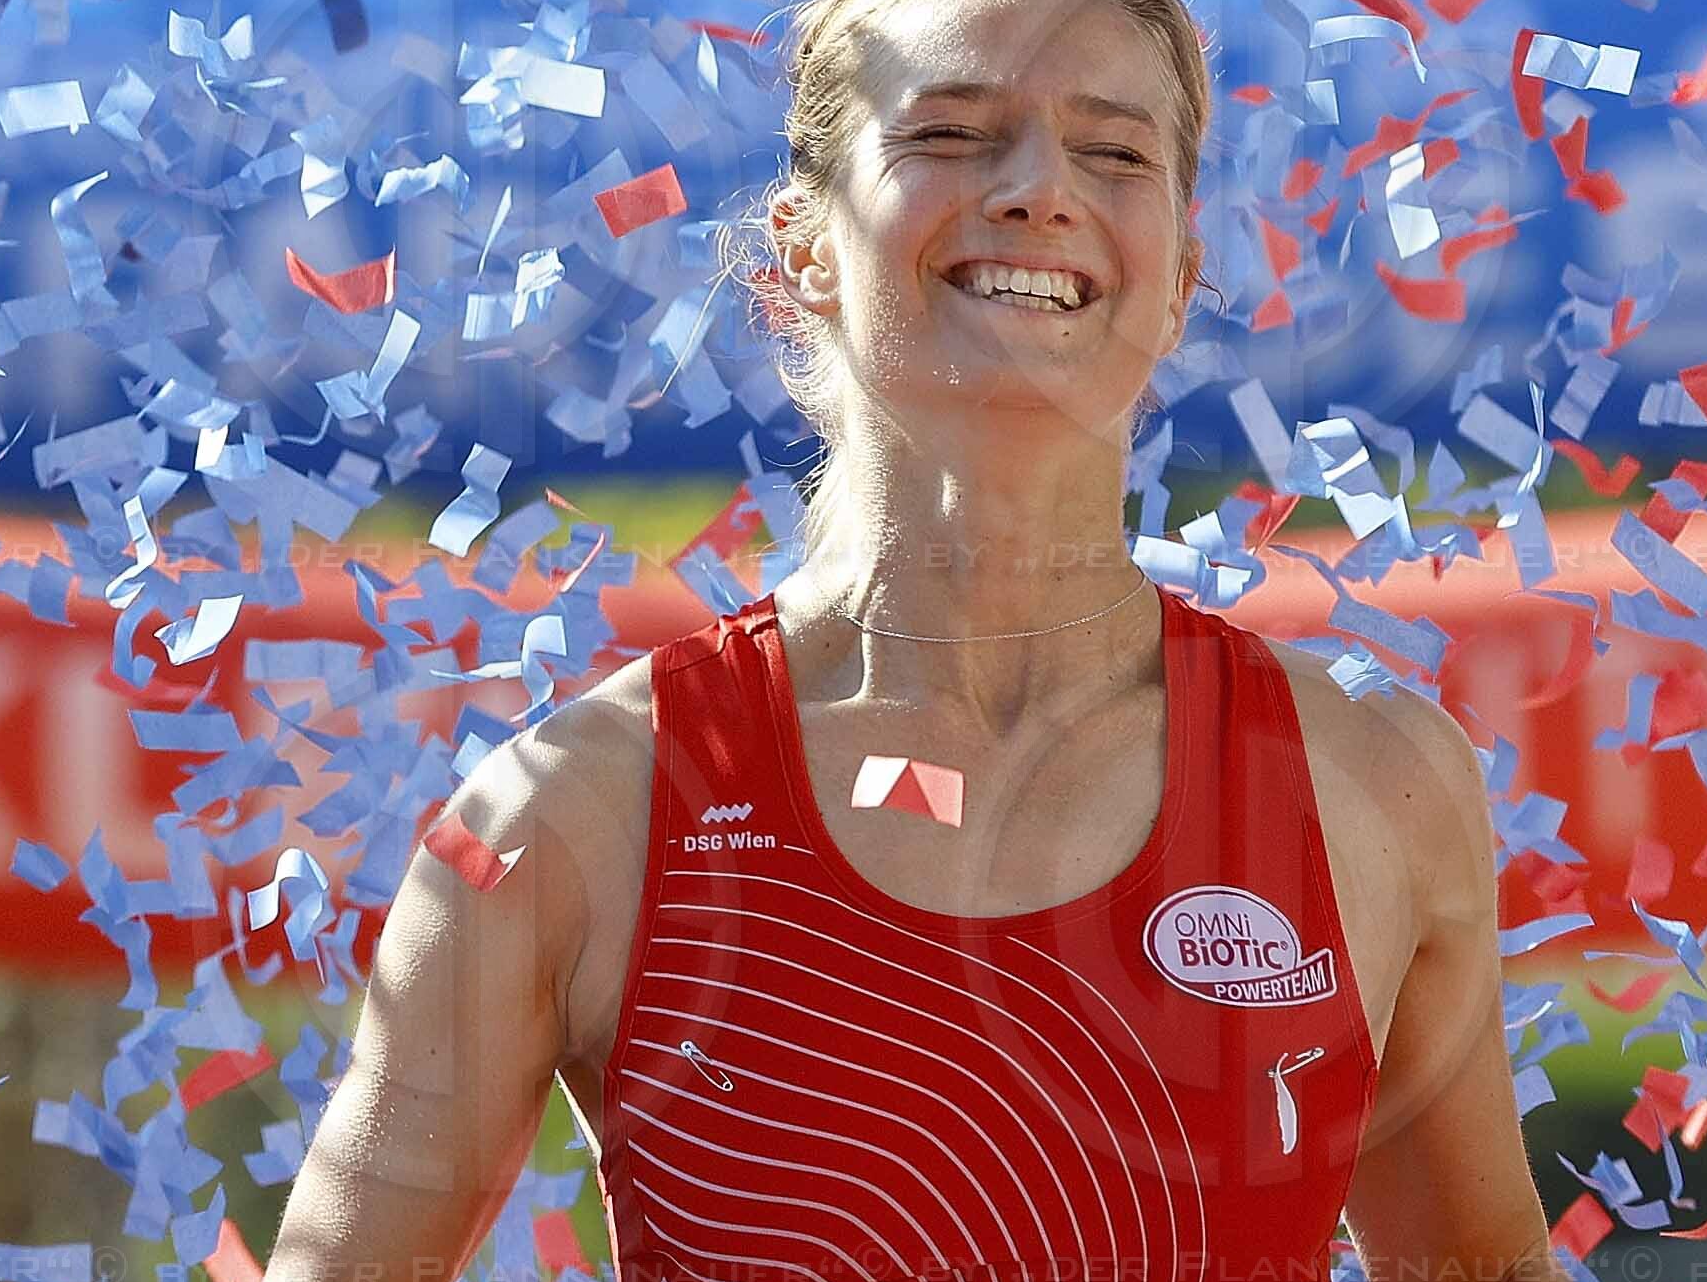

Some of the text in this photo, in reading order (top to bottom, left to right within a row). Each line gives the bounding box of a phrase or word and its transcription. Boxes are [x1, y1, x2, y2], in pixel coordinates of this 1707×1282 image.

[684, 831, 776, 853] DSG Wien
[1214, 960, 1327, 1002] POWERTEAM
